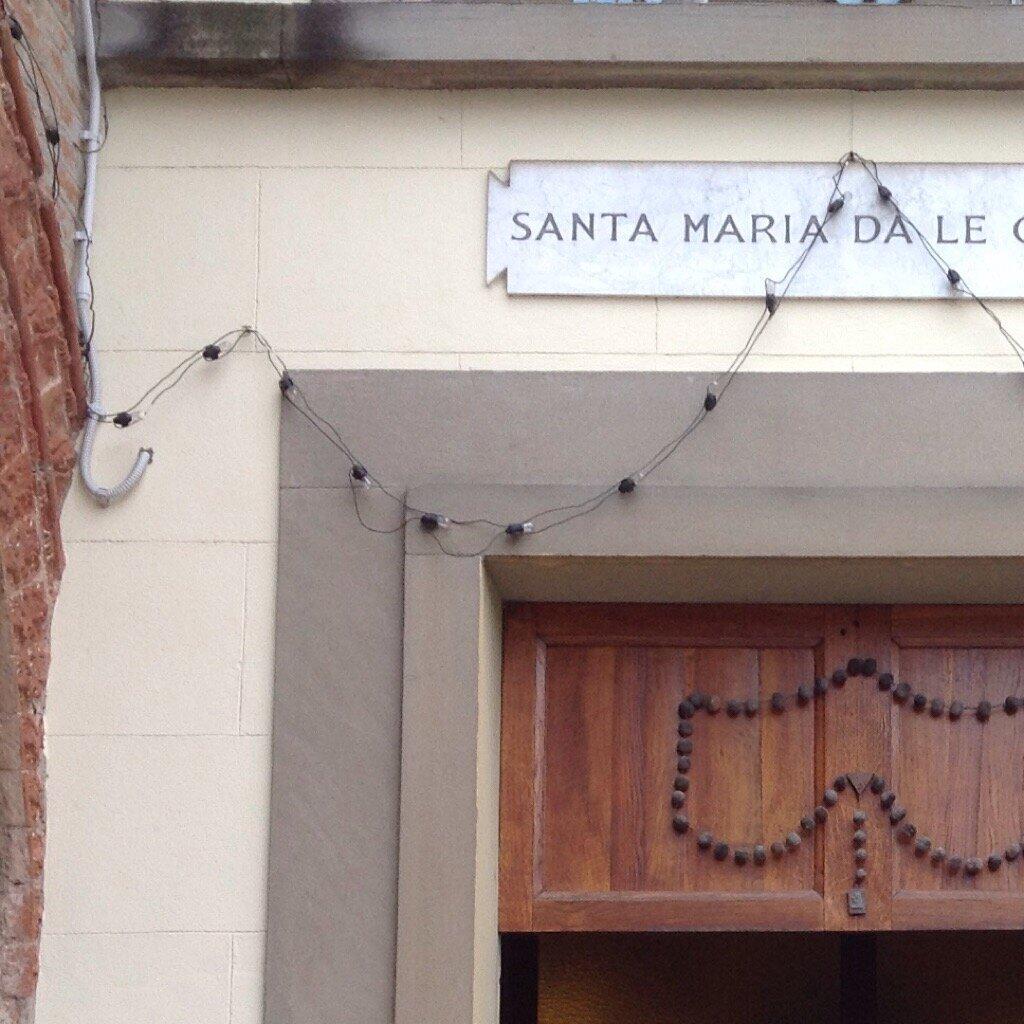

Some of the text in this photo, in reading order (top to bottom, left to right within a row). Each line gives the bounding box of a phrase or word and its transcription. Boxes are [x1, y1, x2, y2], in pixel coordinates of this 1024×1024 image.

[510, 212, 659, 244] SANTA
[682, 212, 829, 245] MARIA
[854, 214, 914, 244] DA
[936, 215, 986, 245] LE
